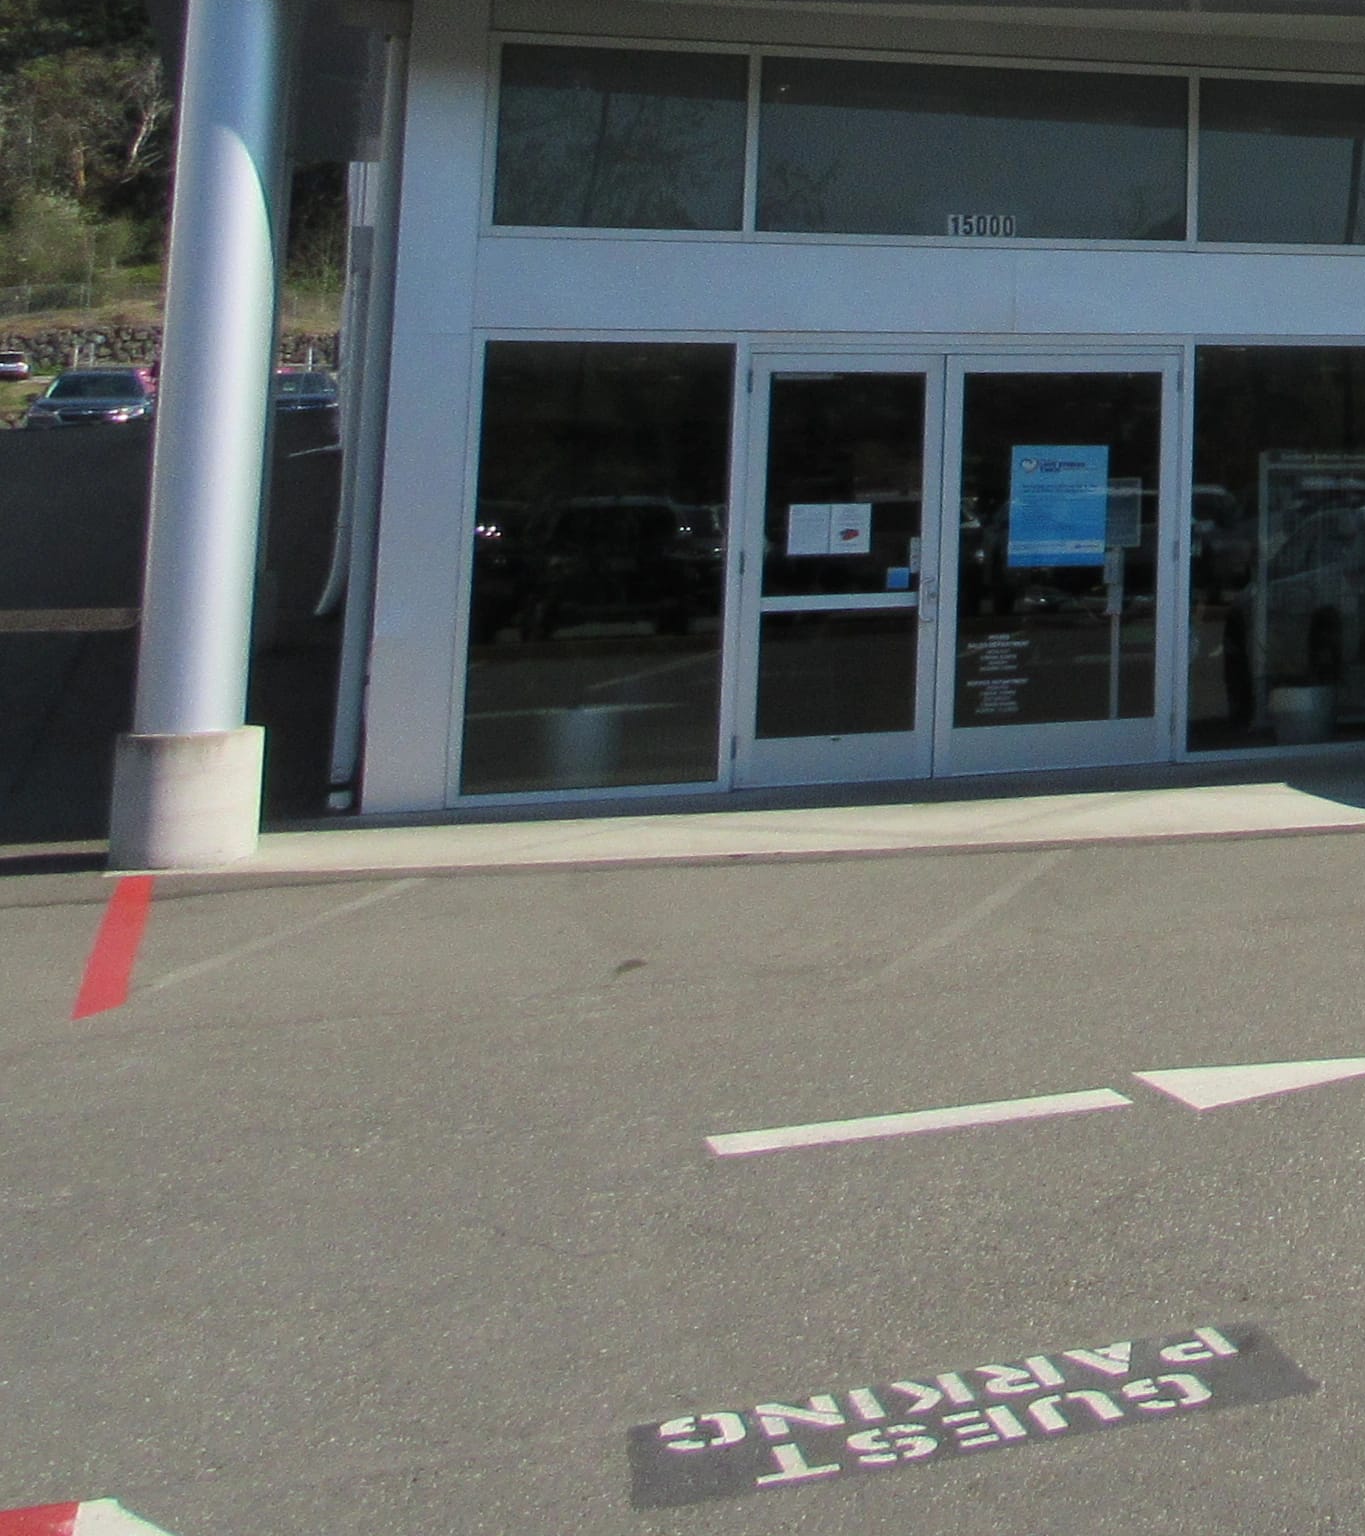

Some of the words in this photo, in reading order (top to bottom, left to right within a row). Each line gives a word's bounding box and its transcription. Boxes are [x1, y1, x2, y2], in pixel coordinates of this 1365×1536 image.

[951, 215, 1014, 236] 15000
[660, 1326, 1239, 1450] PARKING
[756, 1373, 1212, 1486] GUEST
